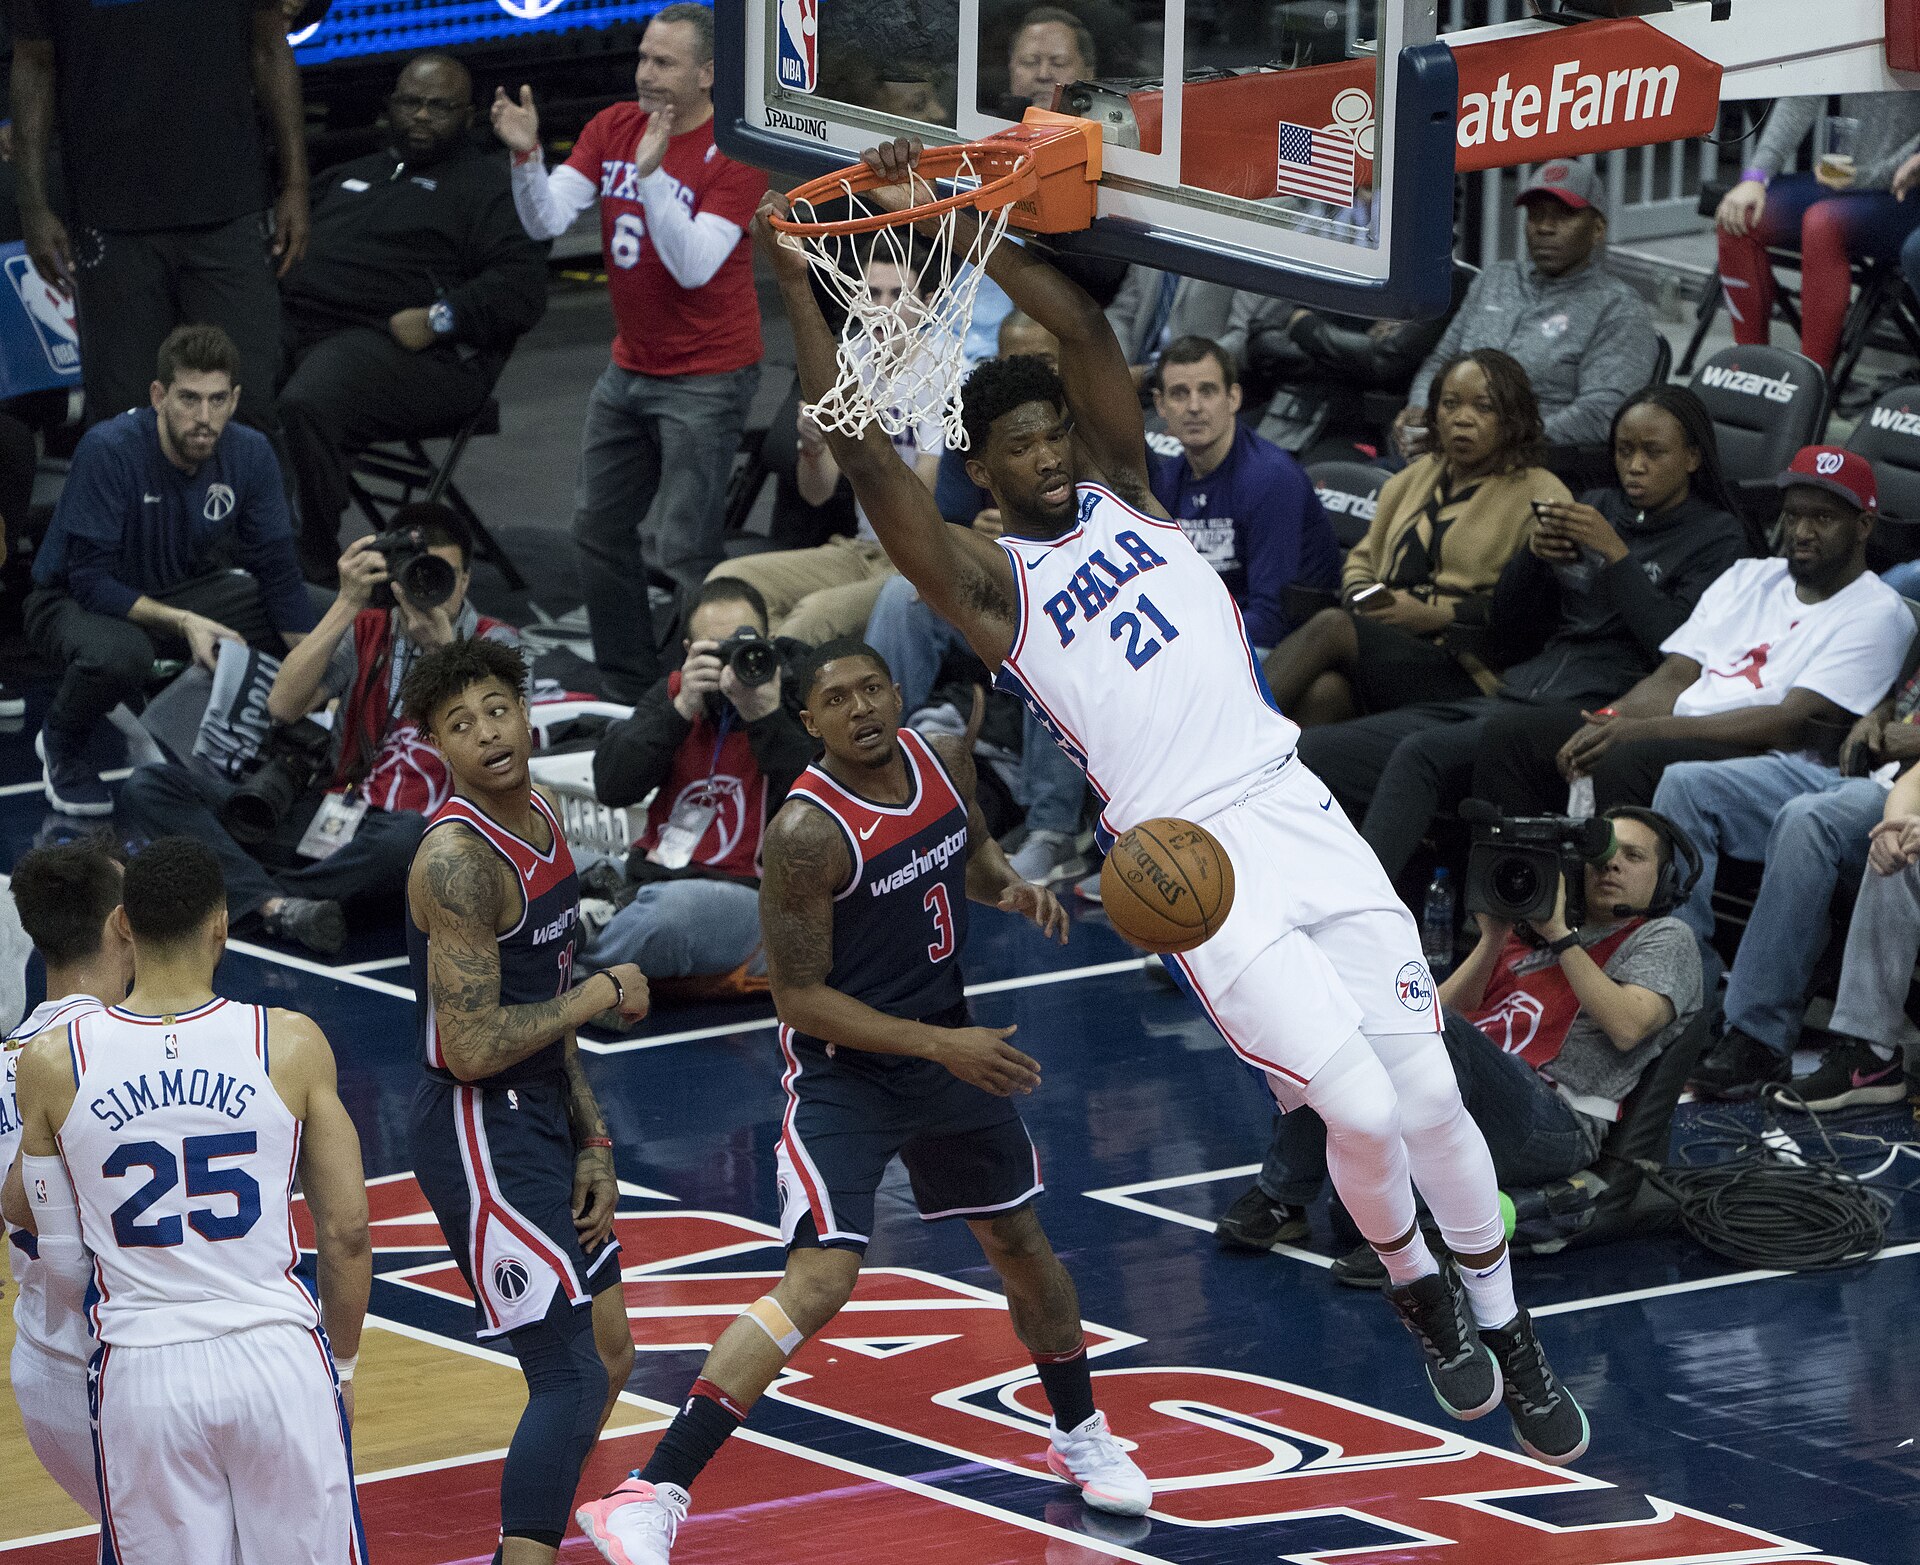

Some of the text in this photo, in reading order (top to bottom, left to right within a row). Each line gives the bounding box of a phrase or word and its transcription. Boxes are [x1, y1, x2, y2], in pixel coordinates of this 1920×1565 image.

[782, 57, 802, 82] NBA
[764, 106, 828, 141] SPALDING
[1456, 59, 1681, 148] ateFarm
[611, 213, 645, 270] 6
[1701, 363, 1799, 403] wizards
[1816, 452, 1844, 474] W
[1043, 530, 1168, 649] PHLA
[1110, 593, 1180, 672] 21
[870, 826, 967, 897] washington
[1119, 831, 1187, 906] SPALDING
[923, 882, 955, 964] 3
[1399, 980, 1432, 999] 76ers
[90, 1068, 256, 1132] SIMMONS
[102, 1130, 262, 1248] 25
